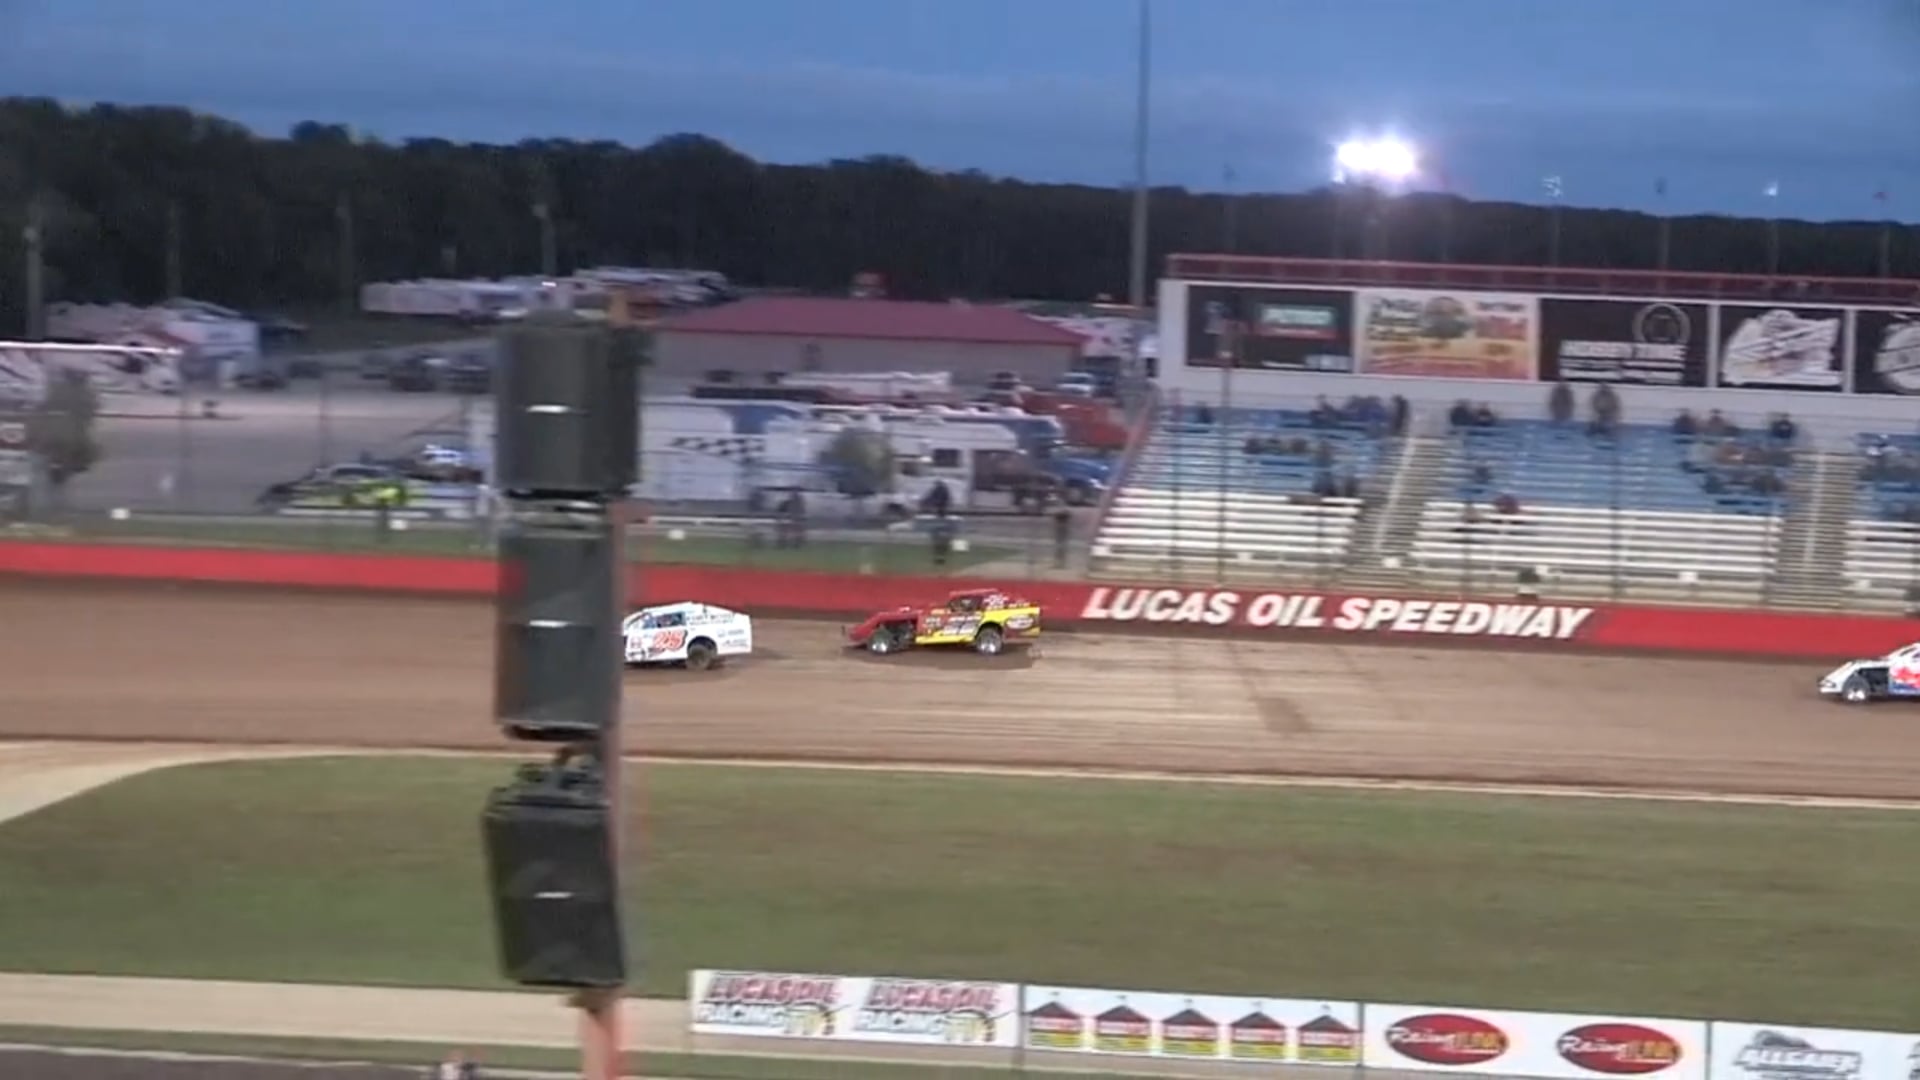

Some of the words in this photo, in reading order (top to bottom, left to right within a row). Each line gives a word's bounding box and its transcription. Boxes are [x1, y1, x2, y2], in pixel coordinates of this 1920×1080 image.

[1080, 587, 1240, 625] LUCAS
[1246, 594, 1327, 628] OIL
[1332, 597, 1591, 638] SPEEDWAY
